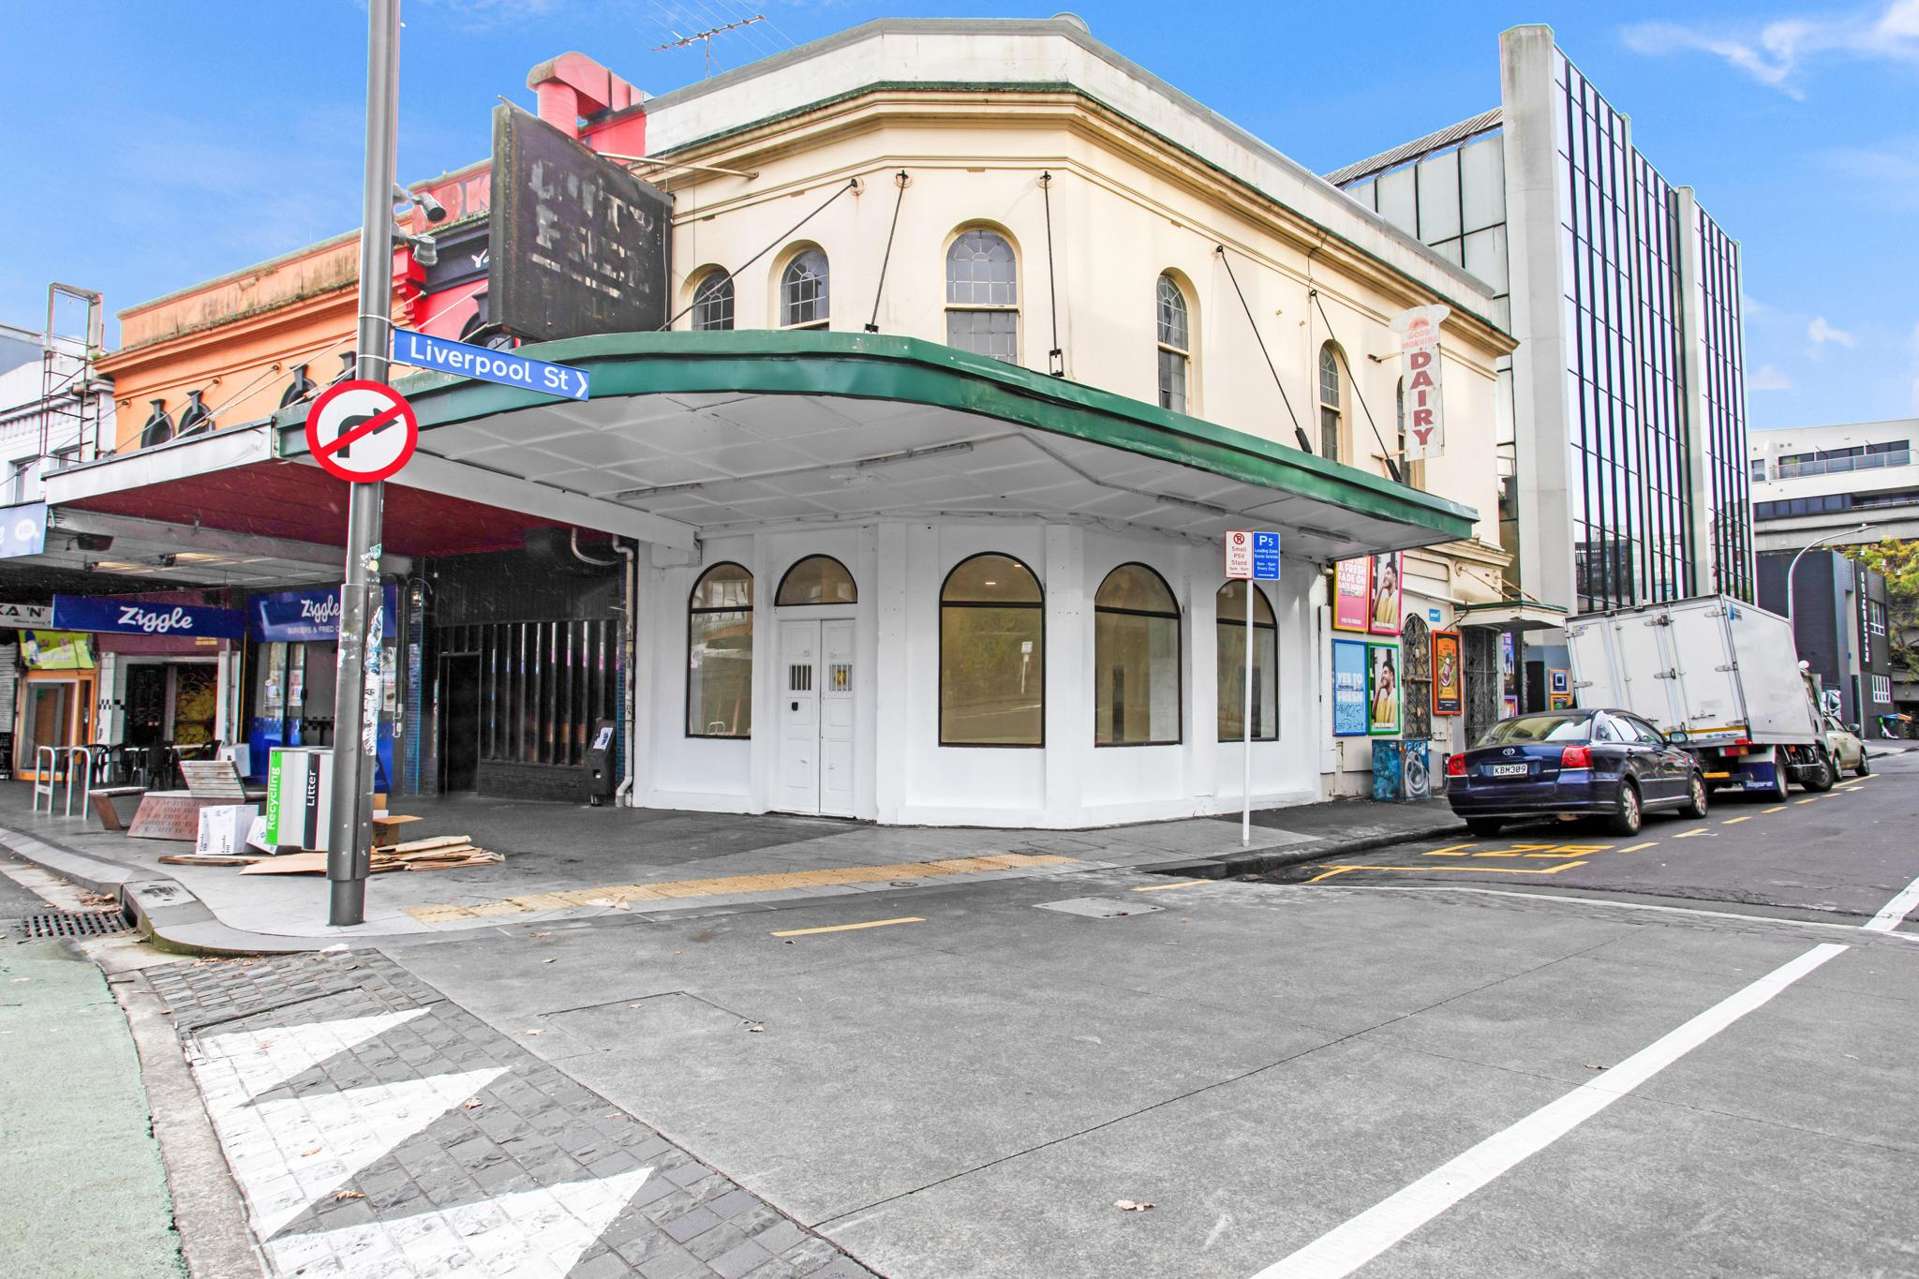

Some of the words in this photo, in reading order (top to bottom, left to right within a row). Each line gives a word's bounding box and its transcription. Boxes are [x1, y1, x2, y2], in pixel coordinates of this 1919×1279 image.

[410, 336, 532, 383] Liverpool
[543, 367, 569, 390] St
[1410, 351, 1434, 446] DAIRY
[118, 606, 193, 632] Ziggle
[301, 594, 341, 623] Ziggle
[267, 767, 280, 830] Recycling
[307, 770, 317, 806] Litter
